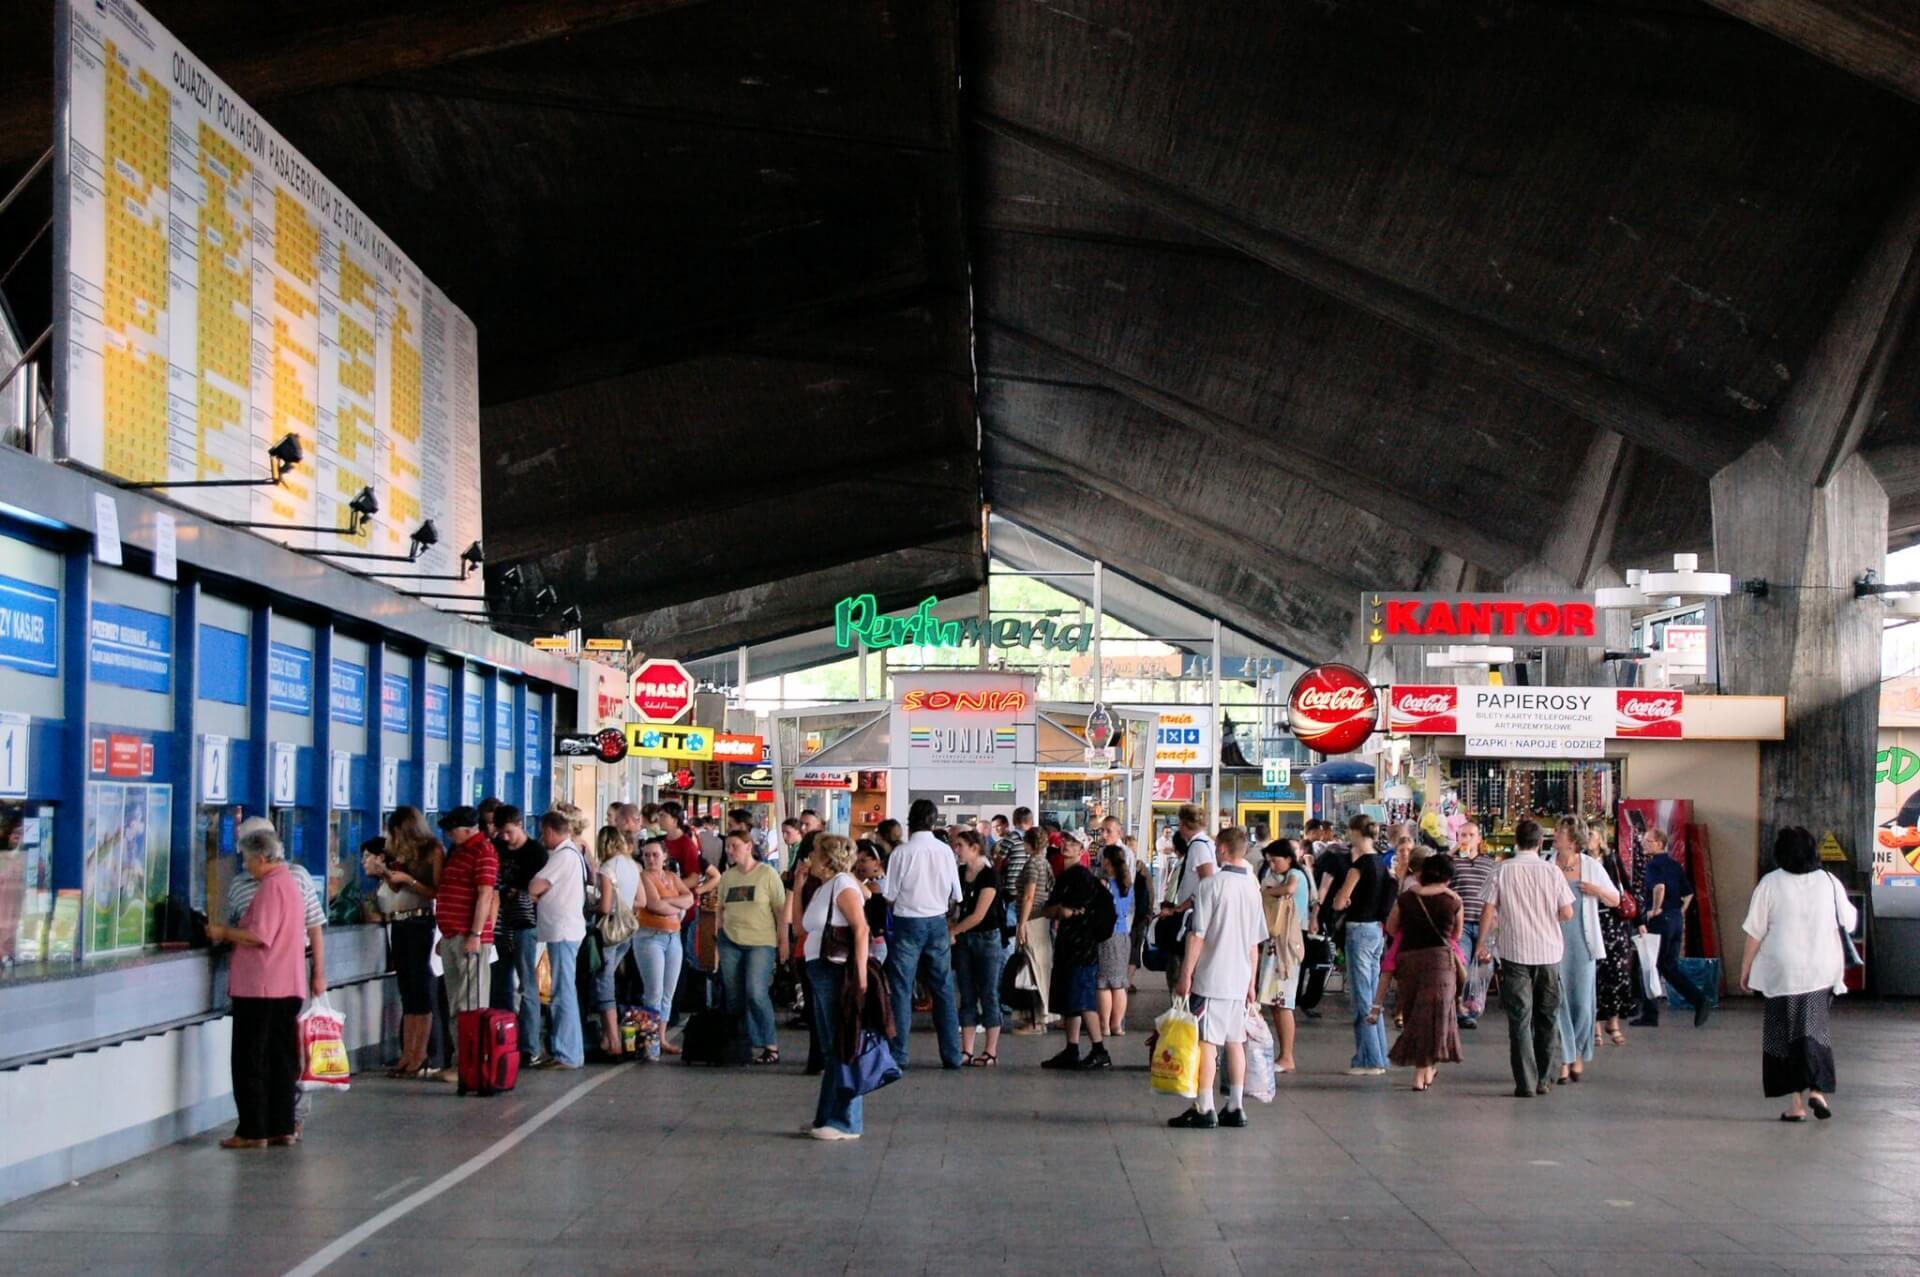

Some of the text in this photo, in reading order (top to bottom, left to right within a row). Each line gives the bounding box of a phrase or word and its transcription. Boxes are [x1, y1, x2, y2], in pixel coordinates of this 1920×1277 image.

[173, 51, 213, 114] ODJAZDY
[333, 197, 342, 228] ZE
[13, 610, 45, 645] KASJER
[835, 594, 1093, 652] Perfumeria
[1386, 599, 1595, 637] KANTOR
[902, 690, 1026, 712] SONIA
[1298, 687, 1368, 711] Coca-Cola
[1400, 693, 1453, 713] Coca-Cola
[1477, 693, 1591, 711] PAPIEROSY
[1623, 697, 1678, 717] Coca-Cola
[1534, 712, 1593, 722] TELEFONICZNE
[634, 730, 704, 751] LOTTO
[932, 728, 994, 753] SONIA
[1468, 738, 1507, 748] CZAPKI
[1515, 740, 1558, 749] NAPOJE
[6, 729, 13, 787] 1
[212, 749, 220, 794] 2
[282, 754, 288, 797] 3
[339, 762, 344, 801] 4
